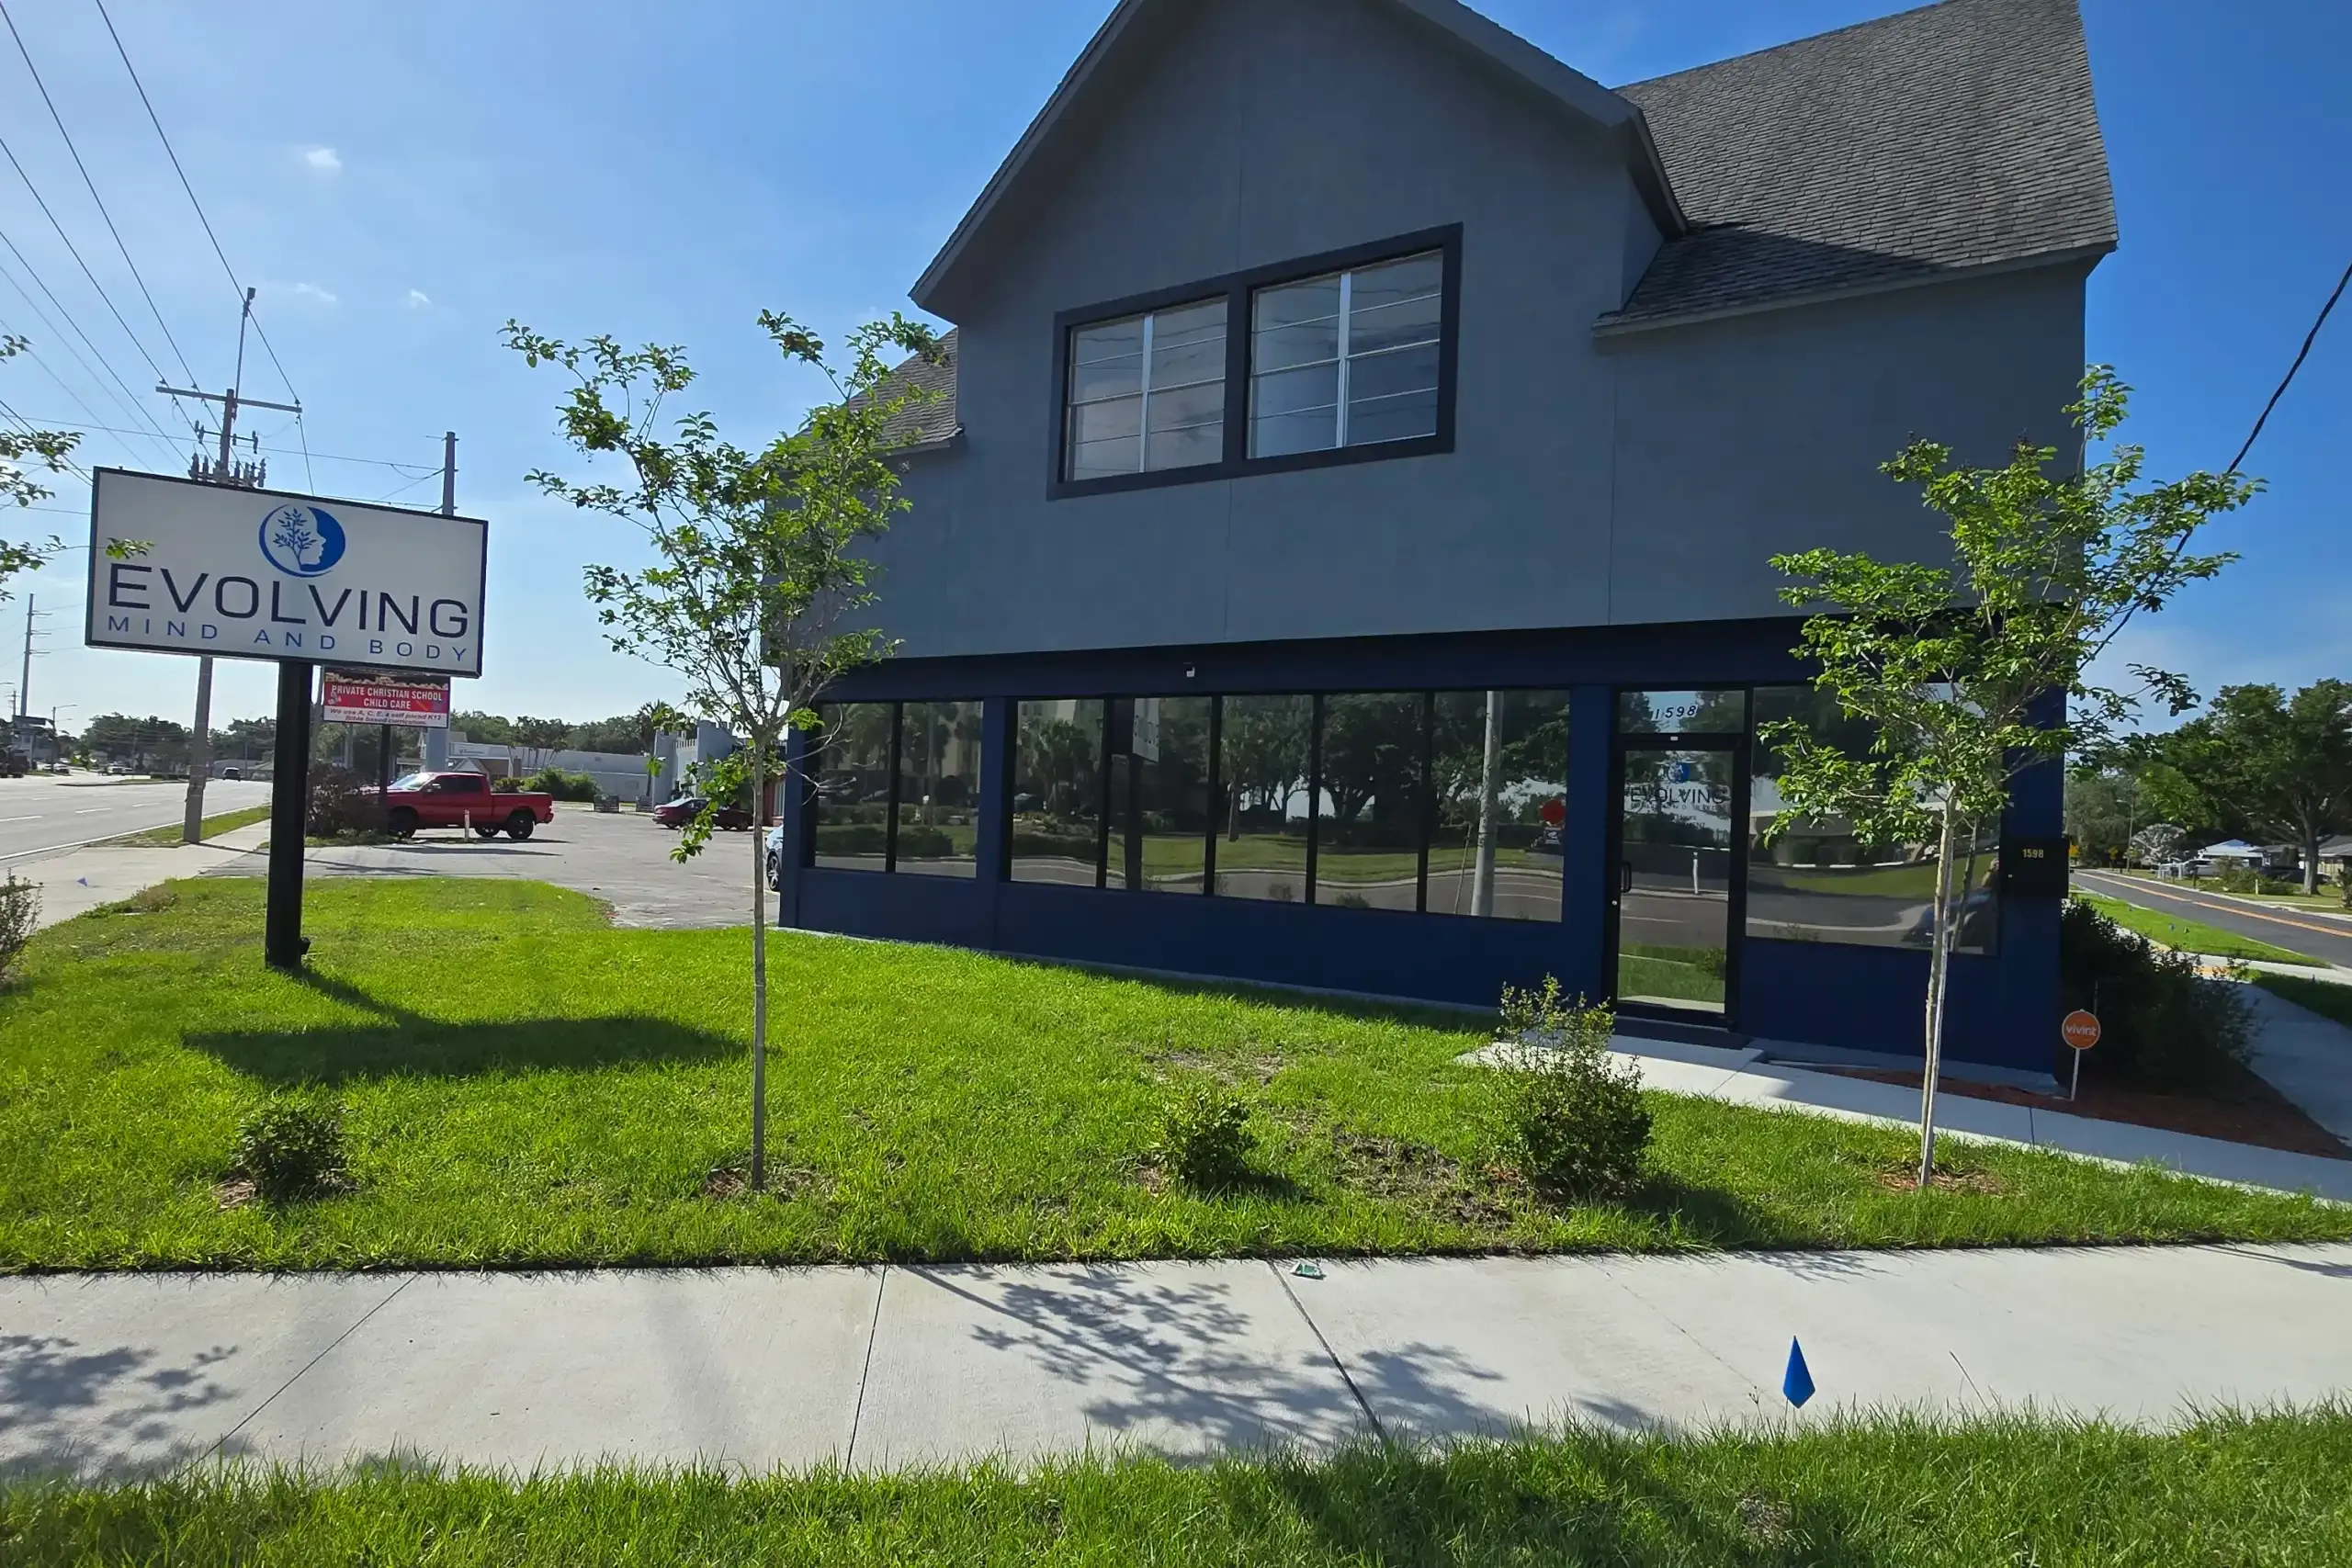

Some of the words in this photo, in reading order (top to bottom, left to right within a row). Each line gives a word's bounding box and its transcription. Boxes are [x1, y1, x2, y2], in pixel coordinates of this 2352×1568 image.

[108, 562, 469, 638] EVOLVING
[108, 615, 219, 639] MIND
[254, 628, 336, 650] AND
[369, 638, 468, 661] BODY
[332, 684, 365, 696] PRIVATE
[367, 687, 409, 699] CHRISTIAN
[411, 690, 443, 701] SCHOOL
[363, 698, 388, 708] CHILD
[390, 699, 412, 710] CARE
[1655, 705, 1697, 719] 1598
[2022, 849, 2044, 859] 1598
[2065, 1023, 2098, 1037] vivint
